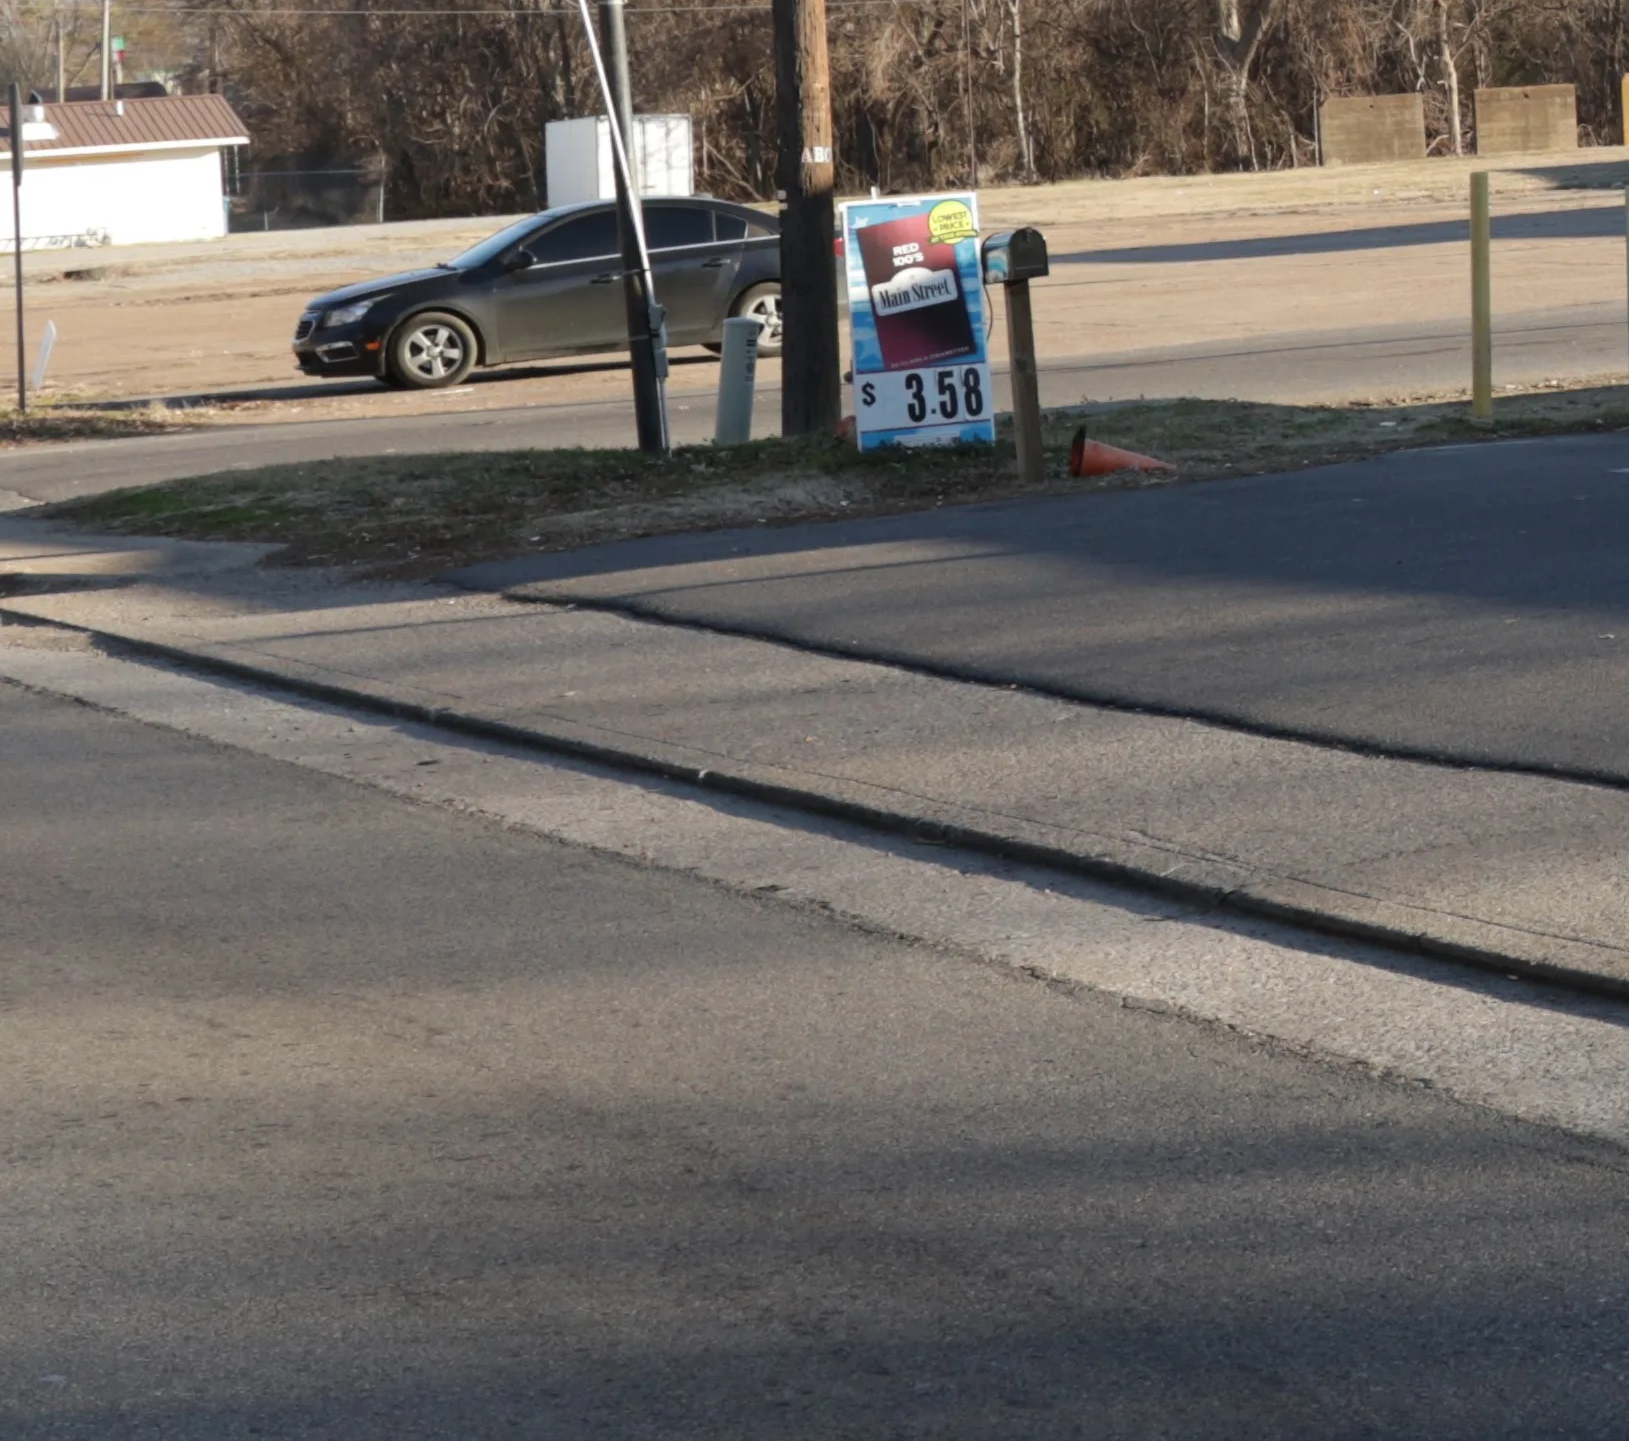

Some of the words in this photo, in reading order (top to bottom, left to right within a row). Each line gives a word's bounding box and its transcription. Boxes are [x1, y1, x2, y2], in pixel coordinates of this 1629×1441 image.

[932, 210, 967, 224] LOWEST
[892, 242, 920, 256] RED
[879, 289, 911, 309] Main
[911, 277, 952, 303] Street
[861, 381, 877, 408] $
[905, 367, 983, 423] 3.58
